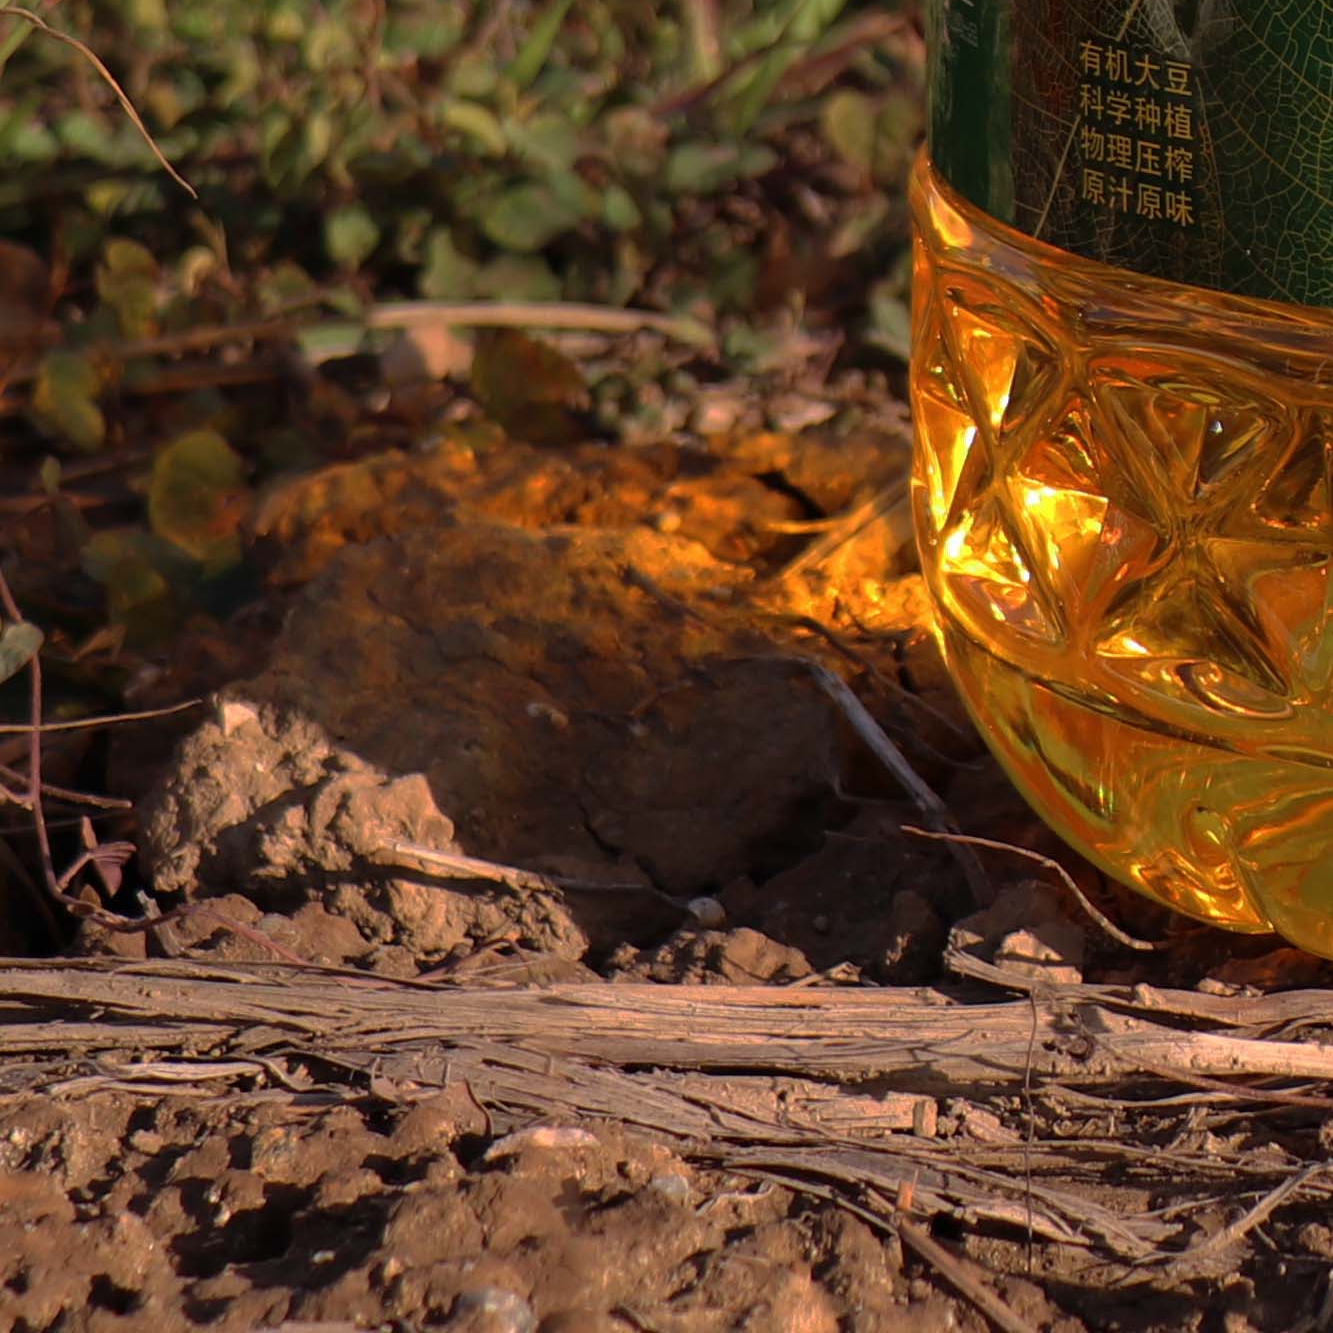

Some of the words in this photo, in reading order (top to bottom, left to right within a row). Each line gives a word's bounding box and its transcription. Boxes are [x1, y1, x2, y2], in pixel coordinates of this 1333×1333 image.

[1080, 39, 1193, 96] 有机大豆
[1080, 84, 1194, 141] 科学种植
[1080, 124, 1193, 183] 物理压榨
[1082, 168, 1195, 227] 原汁原味
